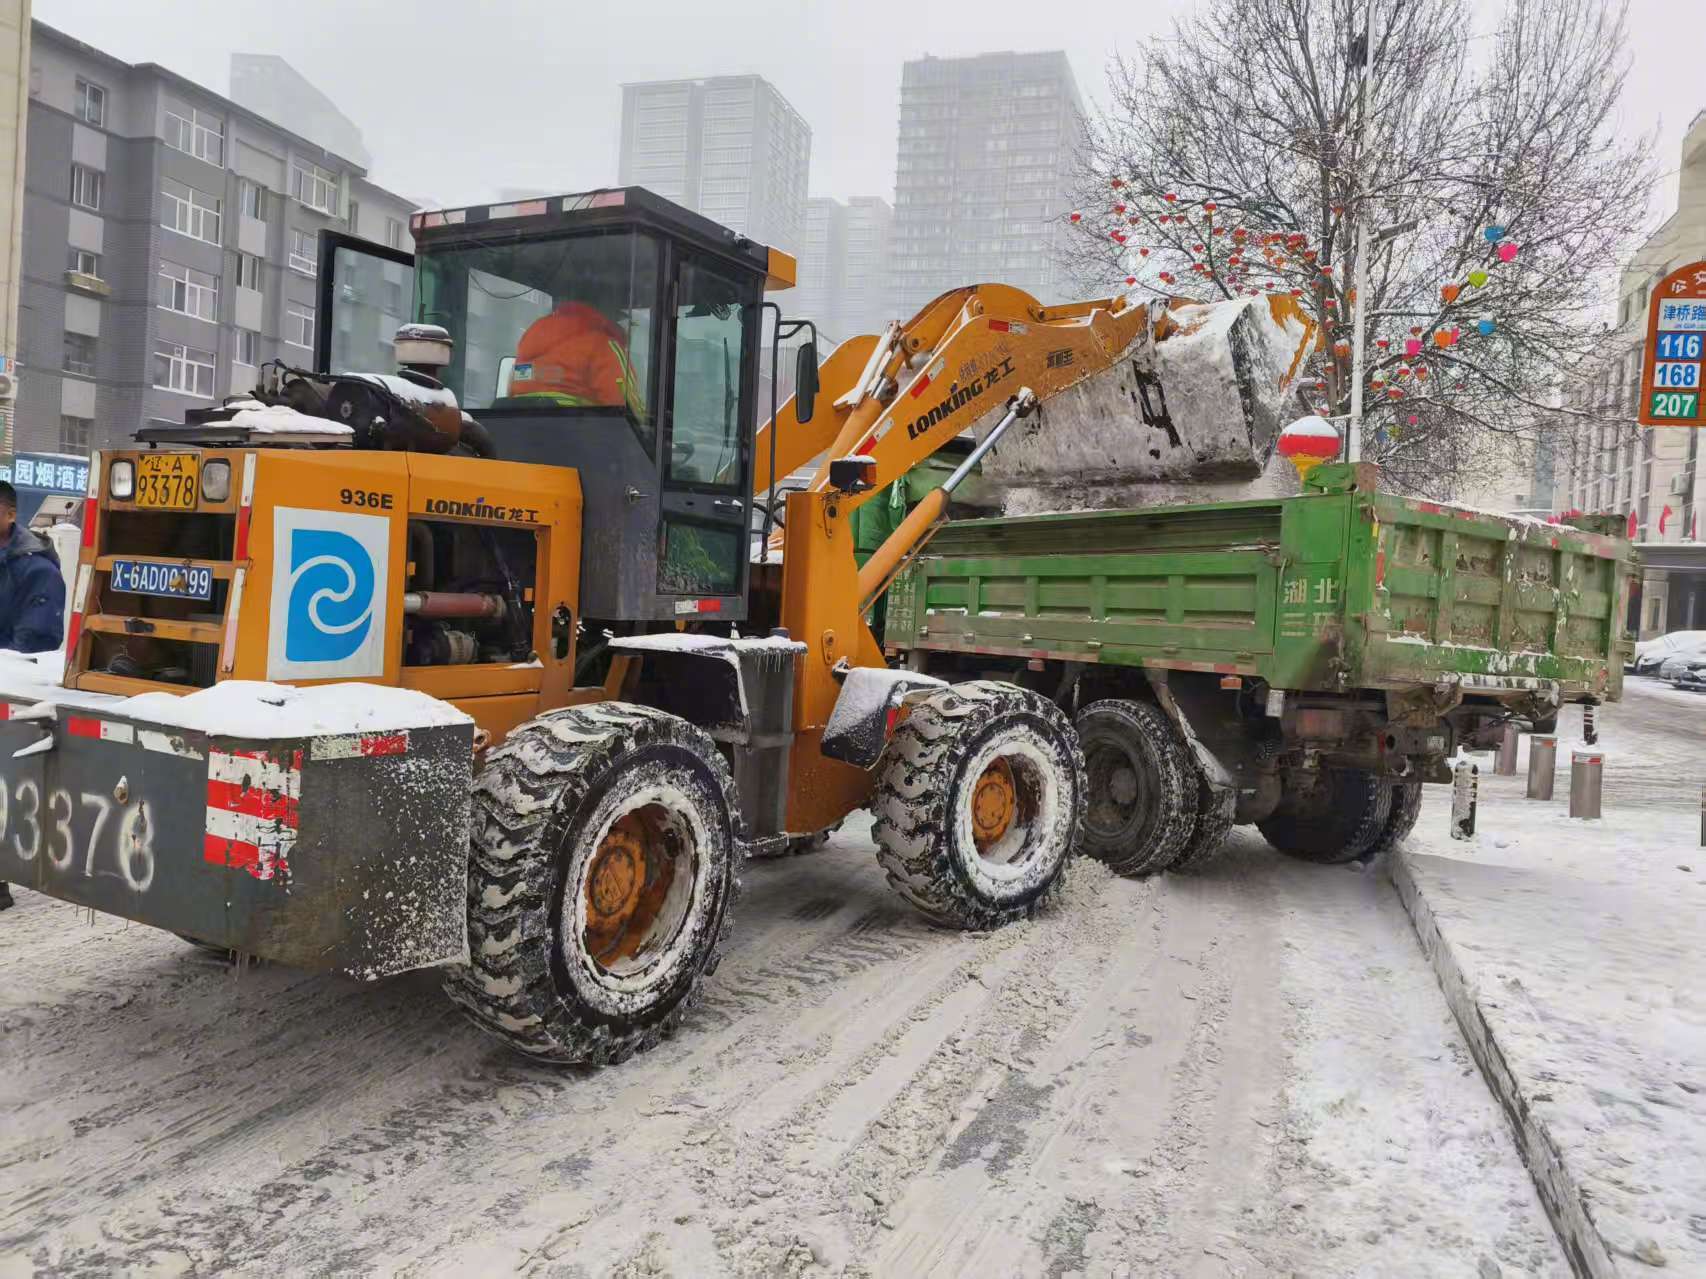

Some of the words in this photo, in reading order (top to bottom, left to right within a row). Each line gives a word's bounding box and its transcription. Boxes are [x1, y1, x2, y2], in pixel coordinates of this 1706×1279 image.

[1661, 334, 1700, 358] 116
[984, 357, 1016, 389] 龙工
[1658, 363, 1696, 386] 168
[1653, 393, 1695, 417] 207
[137, 475, 195, 506] 93378
[340, 488, 394, 510] 936E
[508, 508, 539, 523] 龙工
[1283, 577, 1339, 604] 湖北
